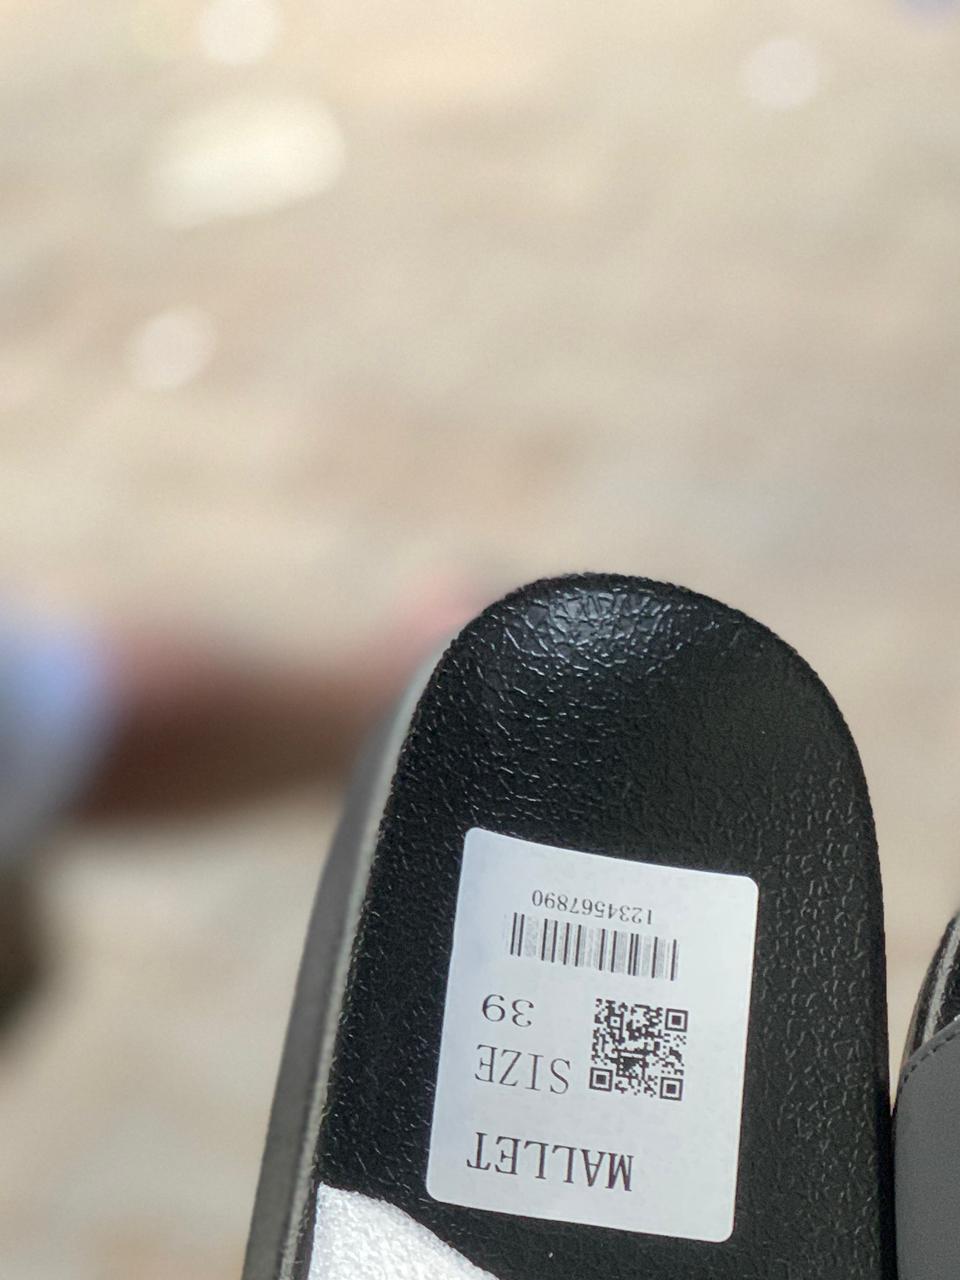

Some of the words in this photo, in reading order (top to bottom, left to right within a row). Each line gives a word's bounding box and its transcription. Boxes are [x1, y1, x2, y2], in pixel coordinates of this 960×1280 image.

[532, 889, 653, 925] 1234567890
[481, 994, 534, 1027] 39
[474, 1044, 571, 1094] SIZE
[466, 1131, 635, 1191] MALLET
